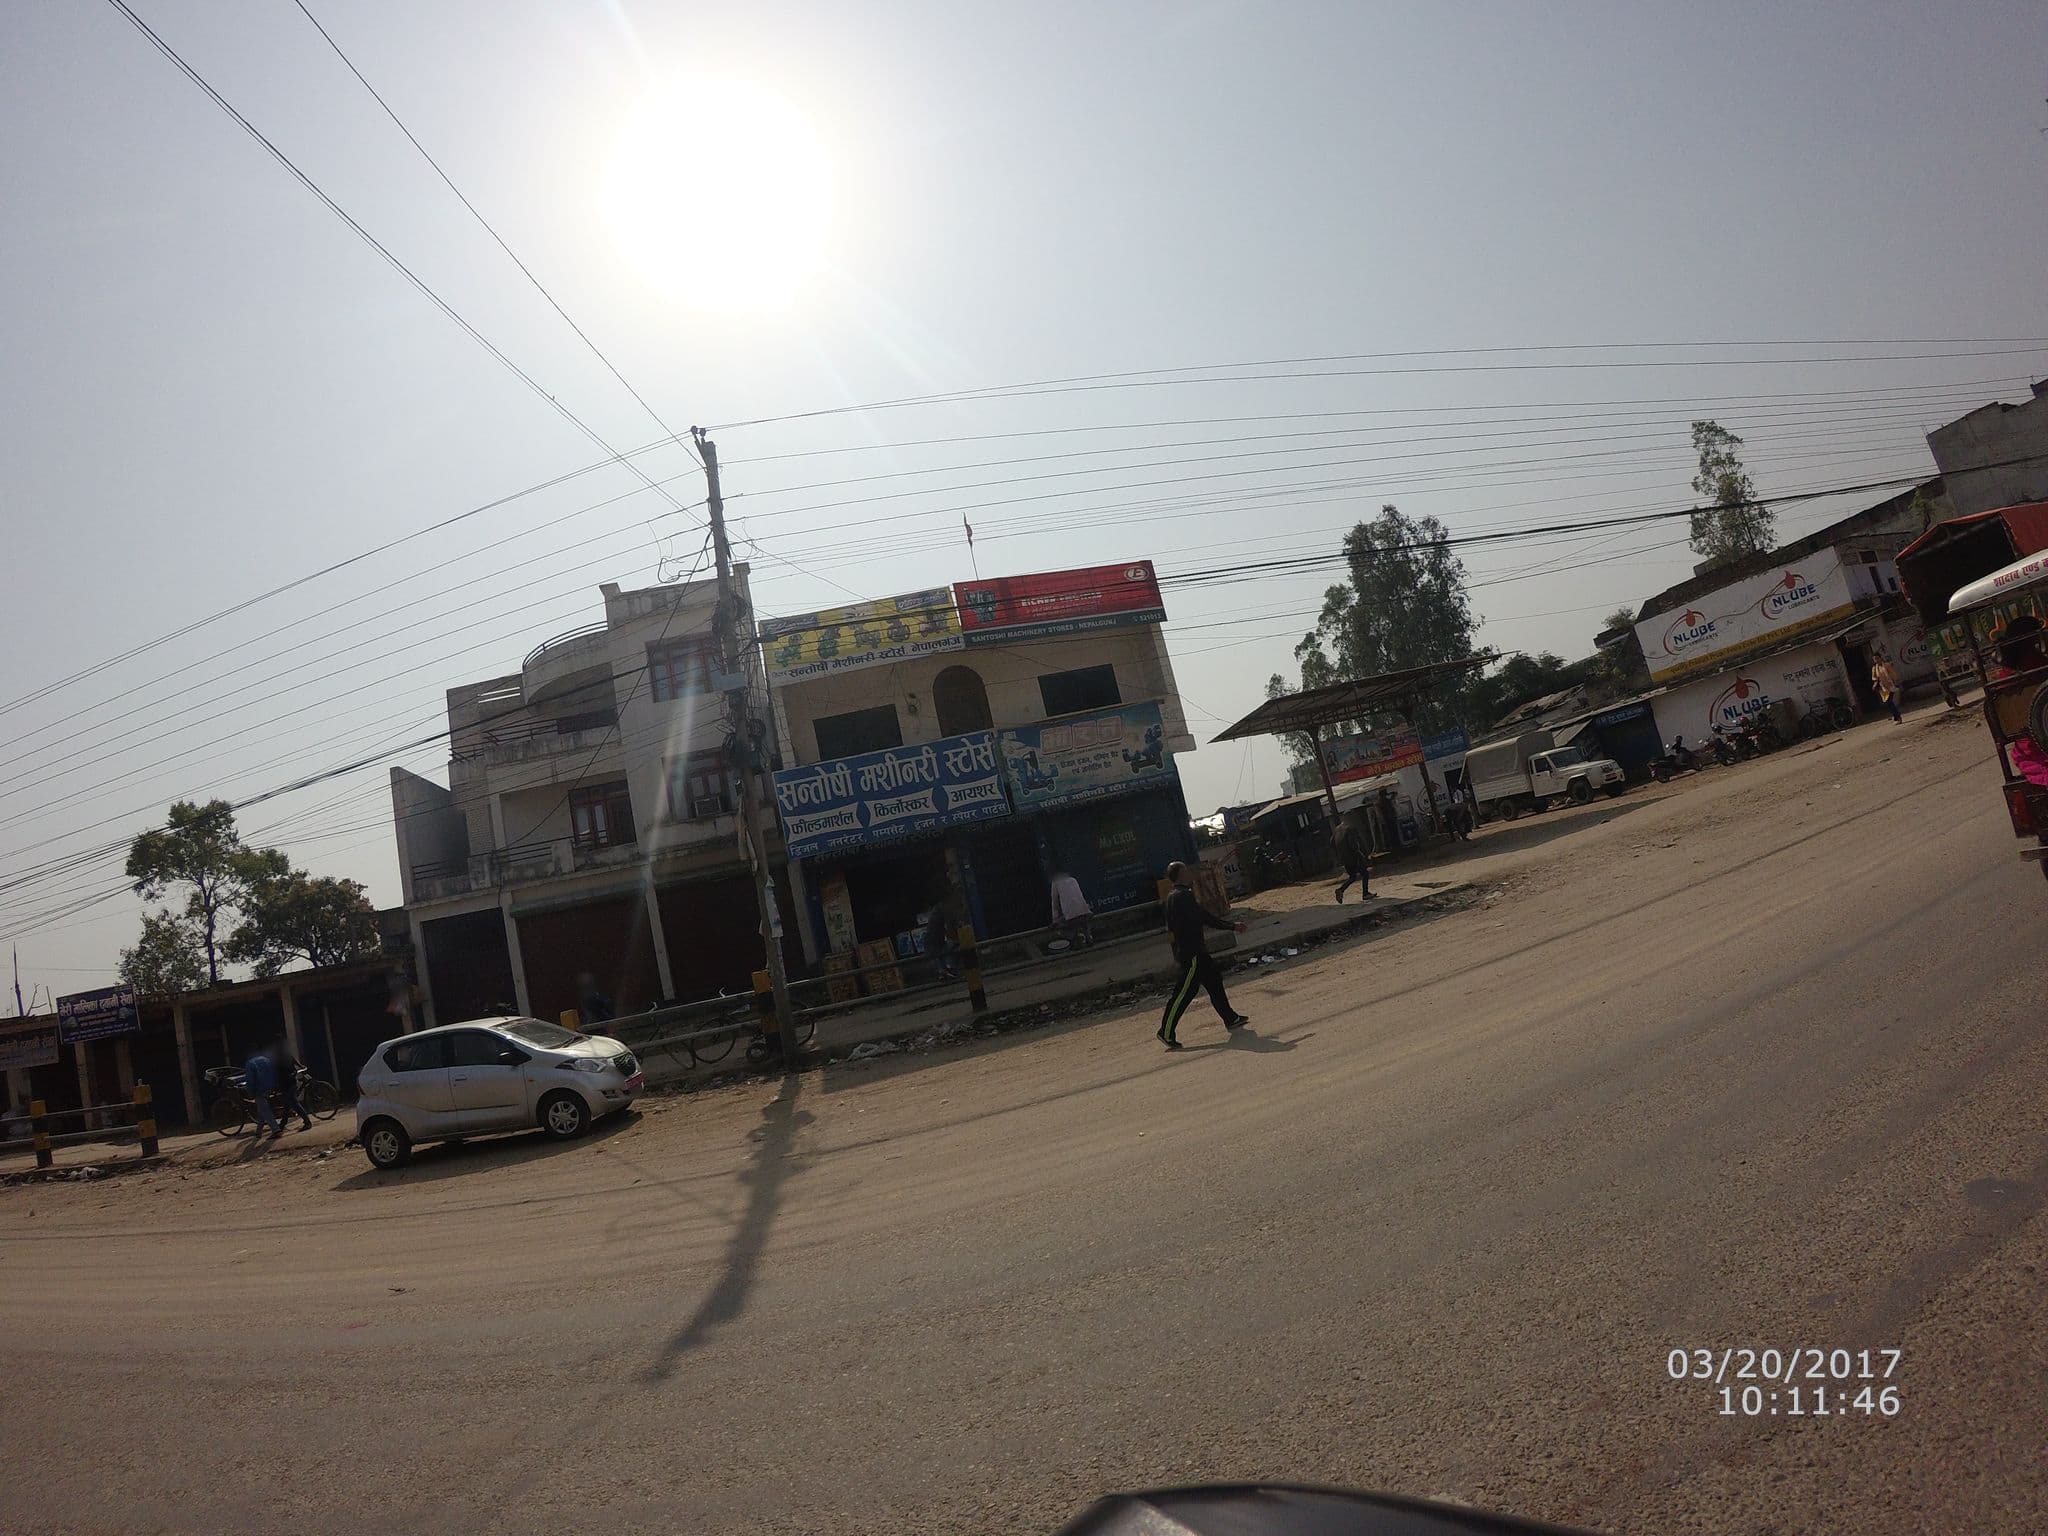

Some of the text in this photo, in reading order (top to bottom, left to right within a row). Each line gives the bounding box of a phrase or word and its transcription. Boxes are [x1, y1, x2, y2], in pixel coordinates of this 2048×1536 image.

[1772, 583, 1817, 608] NLUBE
[972, 632, 1007, 643] SANTOSHI
[1008, 627, 1046, 639] MACHINERY
[1048, 623, 1074, 633] STORES
[1673, 622, 1716, 645] NLUBE
[1722, 695, 1770, 720] NLUBE
[777, 735, 995, 811] सन्तोषी मशीनरी स्टोर्स
[951, 782, 995, 803] आयशर
[873, 796, 930, 818] किर्लोस्कर
[791, 812, 854, 835] फील्डमार्शल
